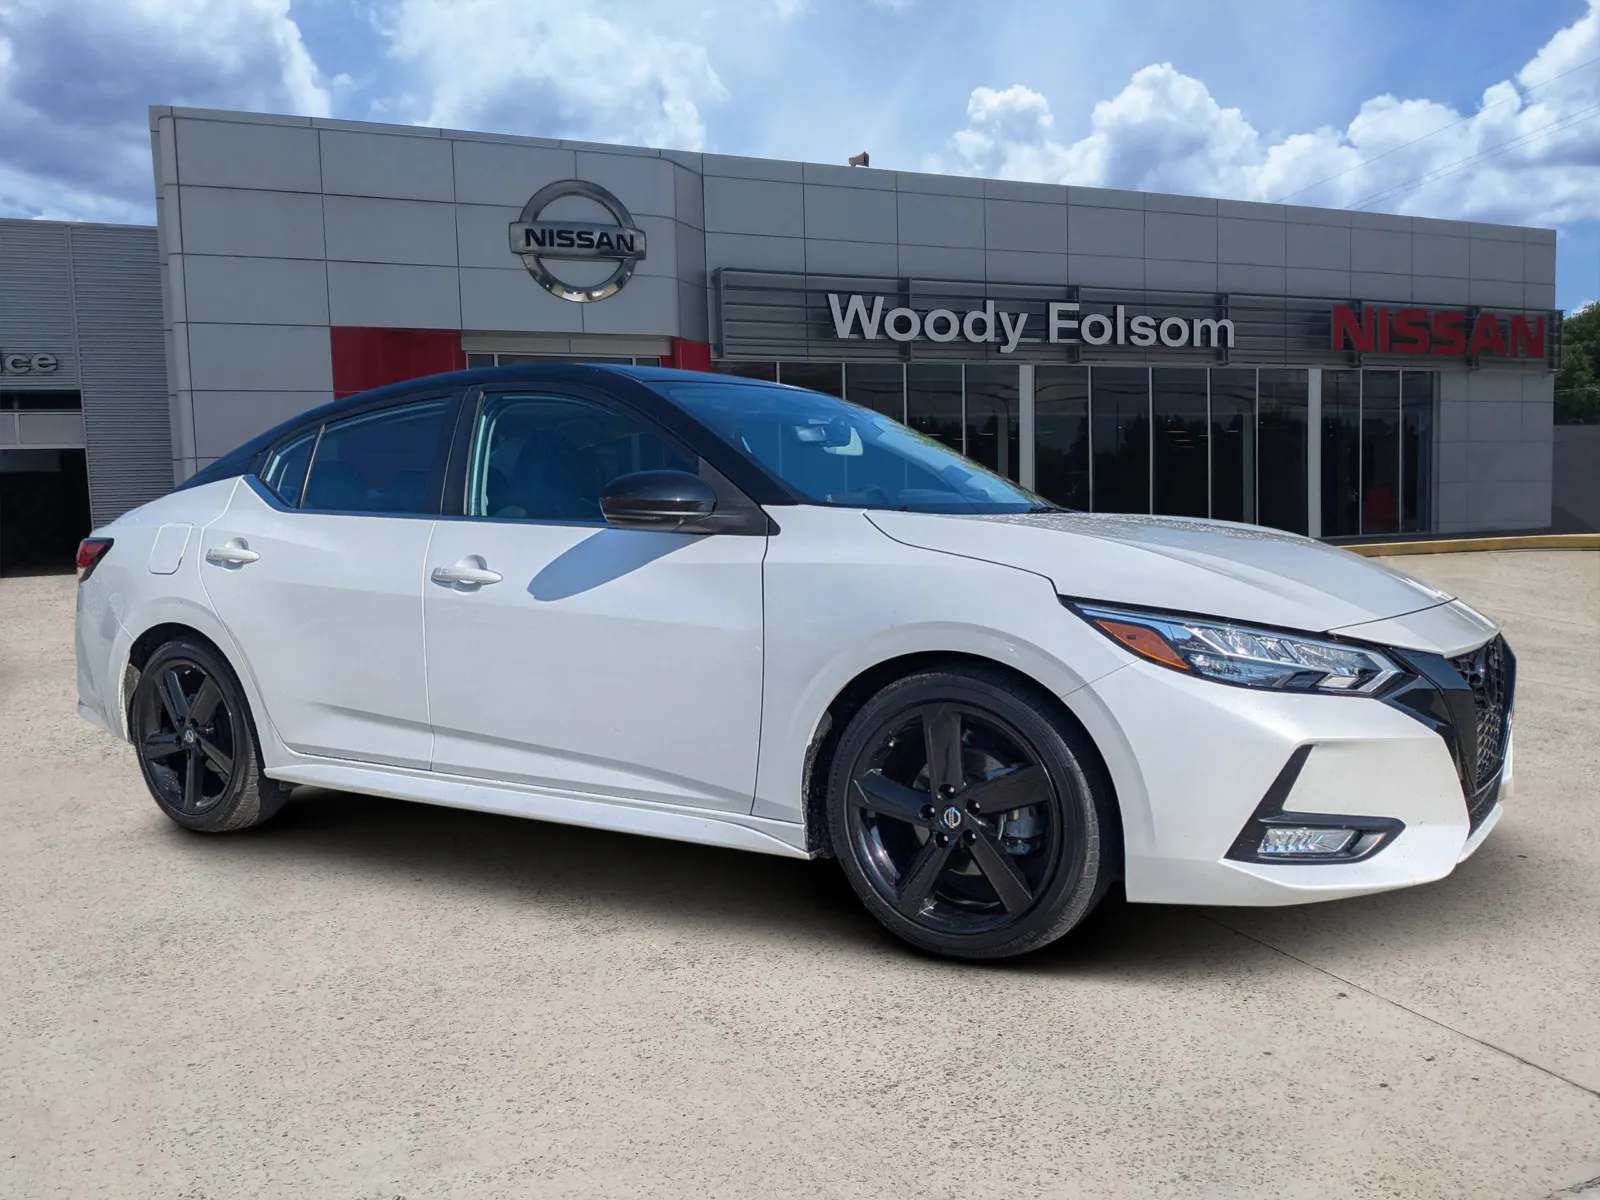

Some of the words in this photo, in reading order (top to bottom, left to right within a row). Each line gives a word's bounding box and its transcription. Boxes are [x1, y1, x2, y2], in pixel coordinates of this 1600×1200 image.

[525, 228, 634, 252] NISSAN
[827, 293, 1028, 354] Woody
[1048, 301, 1236, 348] Folsom
[1333, 305, 1545, 358] NISSAN
[0, 353, 57, 374] ce
